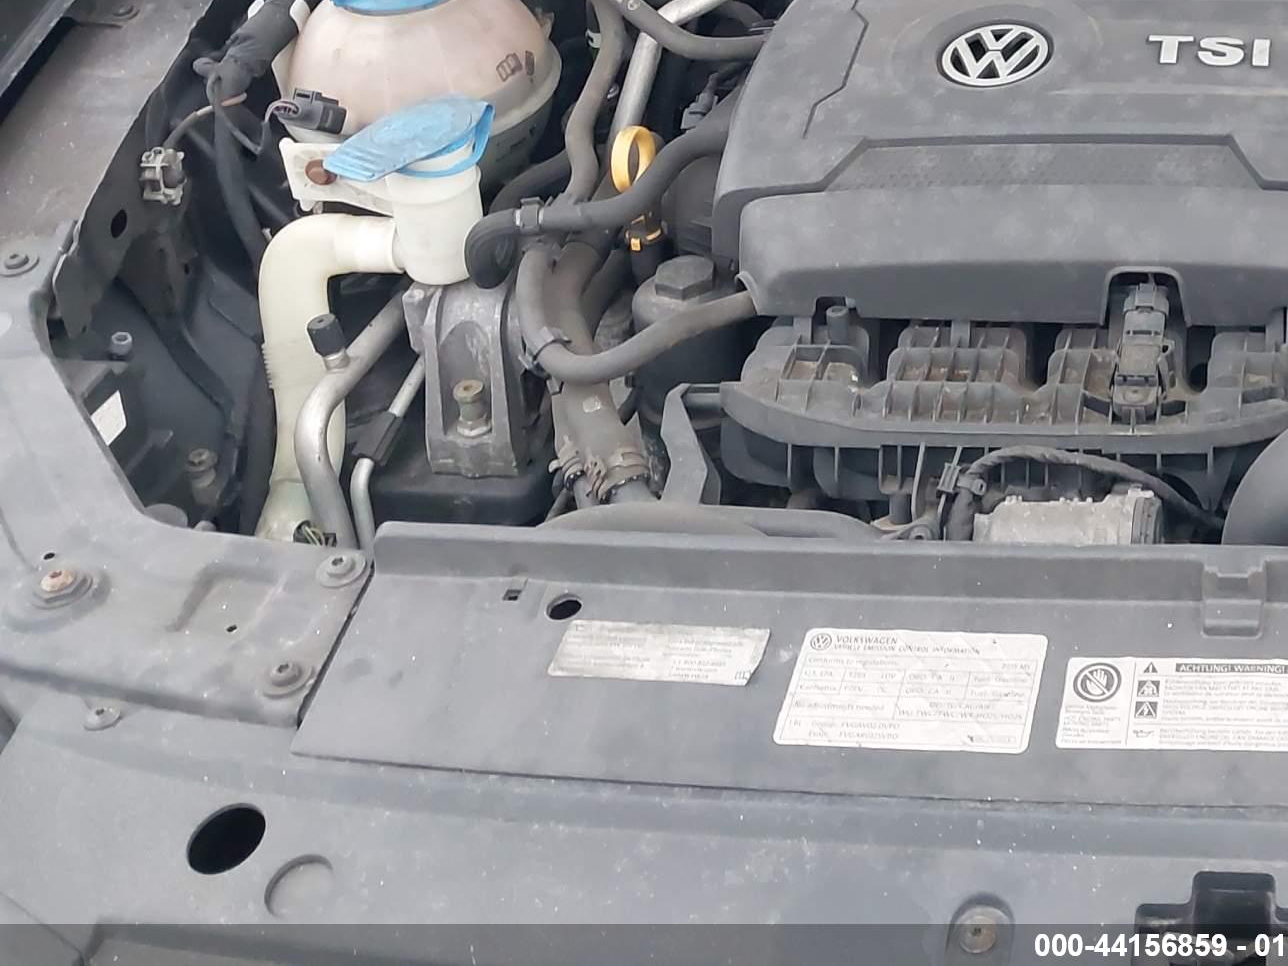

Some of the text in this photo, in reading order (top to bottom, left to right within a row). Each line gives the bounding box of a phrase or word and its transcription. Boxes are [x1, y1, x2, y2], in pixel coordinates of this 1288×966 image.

[1148, 34, 1272, 67] TSI
[836, 635, 898, 645] VOLKSWAGEN
[898, 644, 929, 653] CONTROL
[932, 646, 981, 655] INFORMATION
[1179, 664, 1231, 674] ACHTUNG!
[1233, 664, 1285, 674] WARNING!
